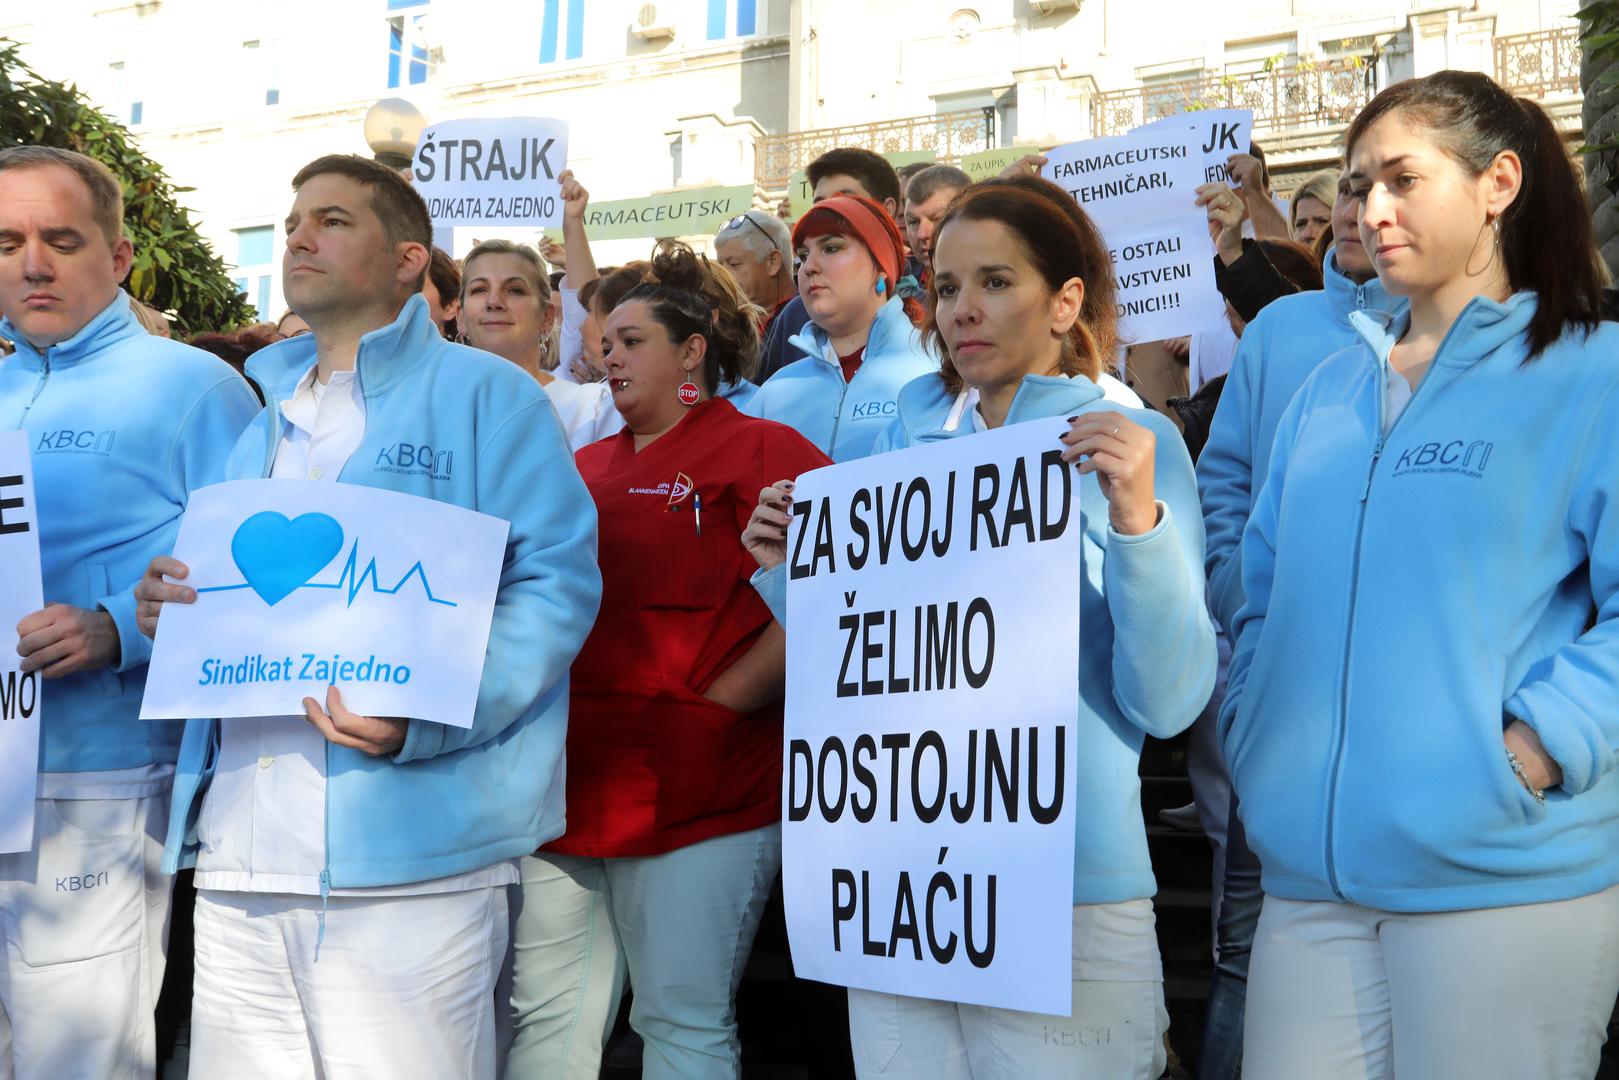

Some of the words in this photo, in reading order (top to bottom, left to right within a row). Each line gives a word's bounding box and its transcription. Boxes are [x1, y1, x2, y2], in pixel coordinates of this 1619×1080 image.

[1202, 122, 1240, 154] JK
[415, 132, 555, 182] ŠTRAJK
[984, 159, 1006, 169] UPIS
[1054, 145, 1187, 179] FARMACEUTSKI
[1070, 172, 1173, 203] TEHNIČARI,
[428, 198, 482, 219] DIKATA
[485, 197, 555, 219] ZAJEDNO
[583, 198, 731, 226] RMACEUTSKI
[1109, 249, 1118, 264] E
[1122, 237, 1181, 262] OSTALI
[1115, 263, 1192, 290] VSTVENI
[1115, 292, 1181, 319] DNICI!!!
[680, 389, 698, 398] STOP
[852, 401, 896, 417] KBC
[0, 475, 30, 535] E
[790, 496, 836, 580] ZA
[847, 470, 956, 571] SVOJ
[970, 449, 1072, 552] RAD
[837, 590, 996, 698] ŽELIMO
[199, 653, 293, 686] Sindikat
[298, 653, 411, 687] Zajedno
[0, 670, 36, 720] MO
[788, 725, 1066, 825] DOSTOJNU
[832, 846, 997, 968] PLAĆU
